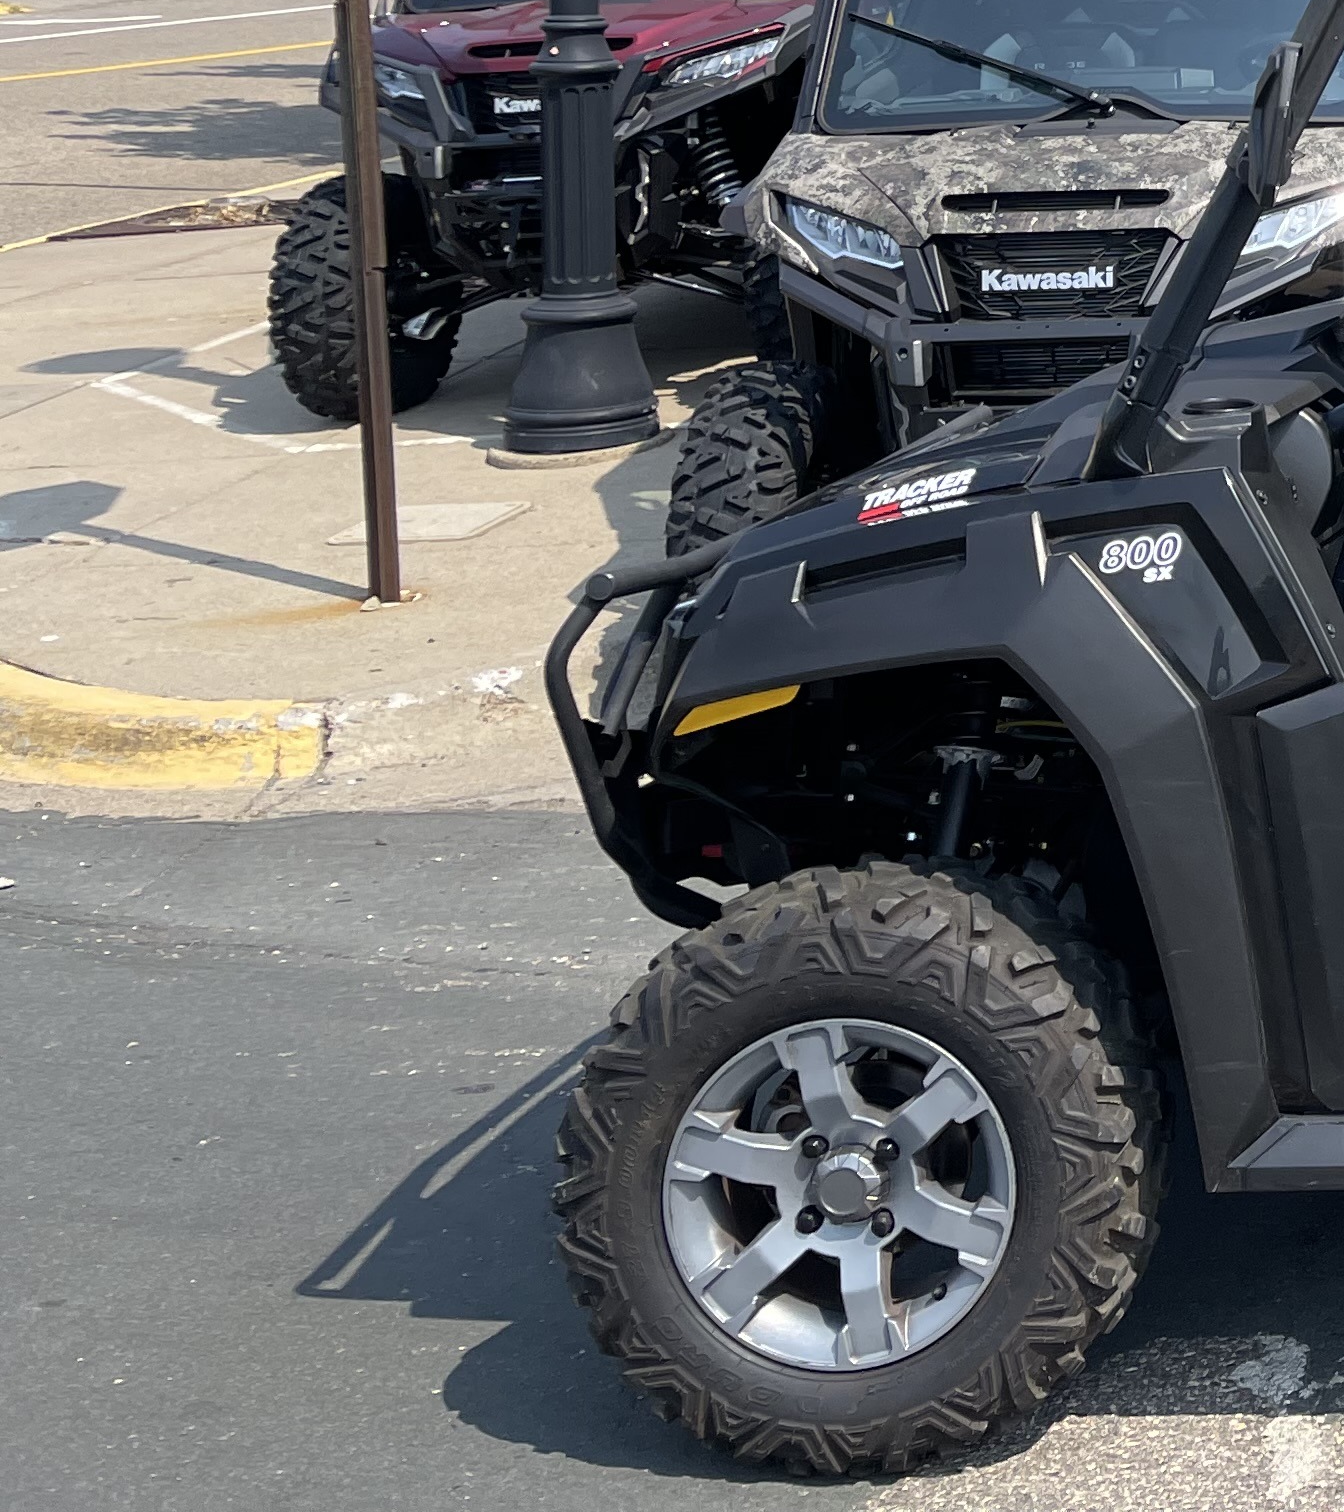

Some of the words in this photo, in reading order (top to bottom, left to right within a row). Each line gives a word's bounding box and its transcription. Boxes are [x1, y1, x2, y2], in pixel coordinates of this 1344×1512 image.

[981, 266, 1115, 292] Kawasaki
[862, 468, 977, 511] TRACKER
[927, 485, 969, 502] ROAD
[1099, 532, 1182, 574] 800
[1142, 565, 1175, 583] SX
